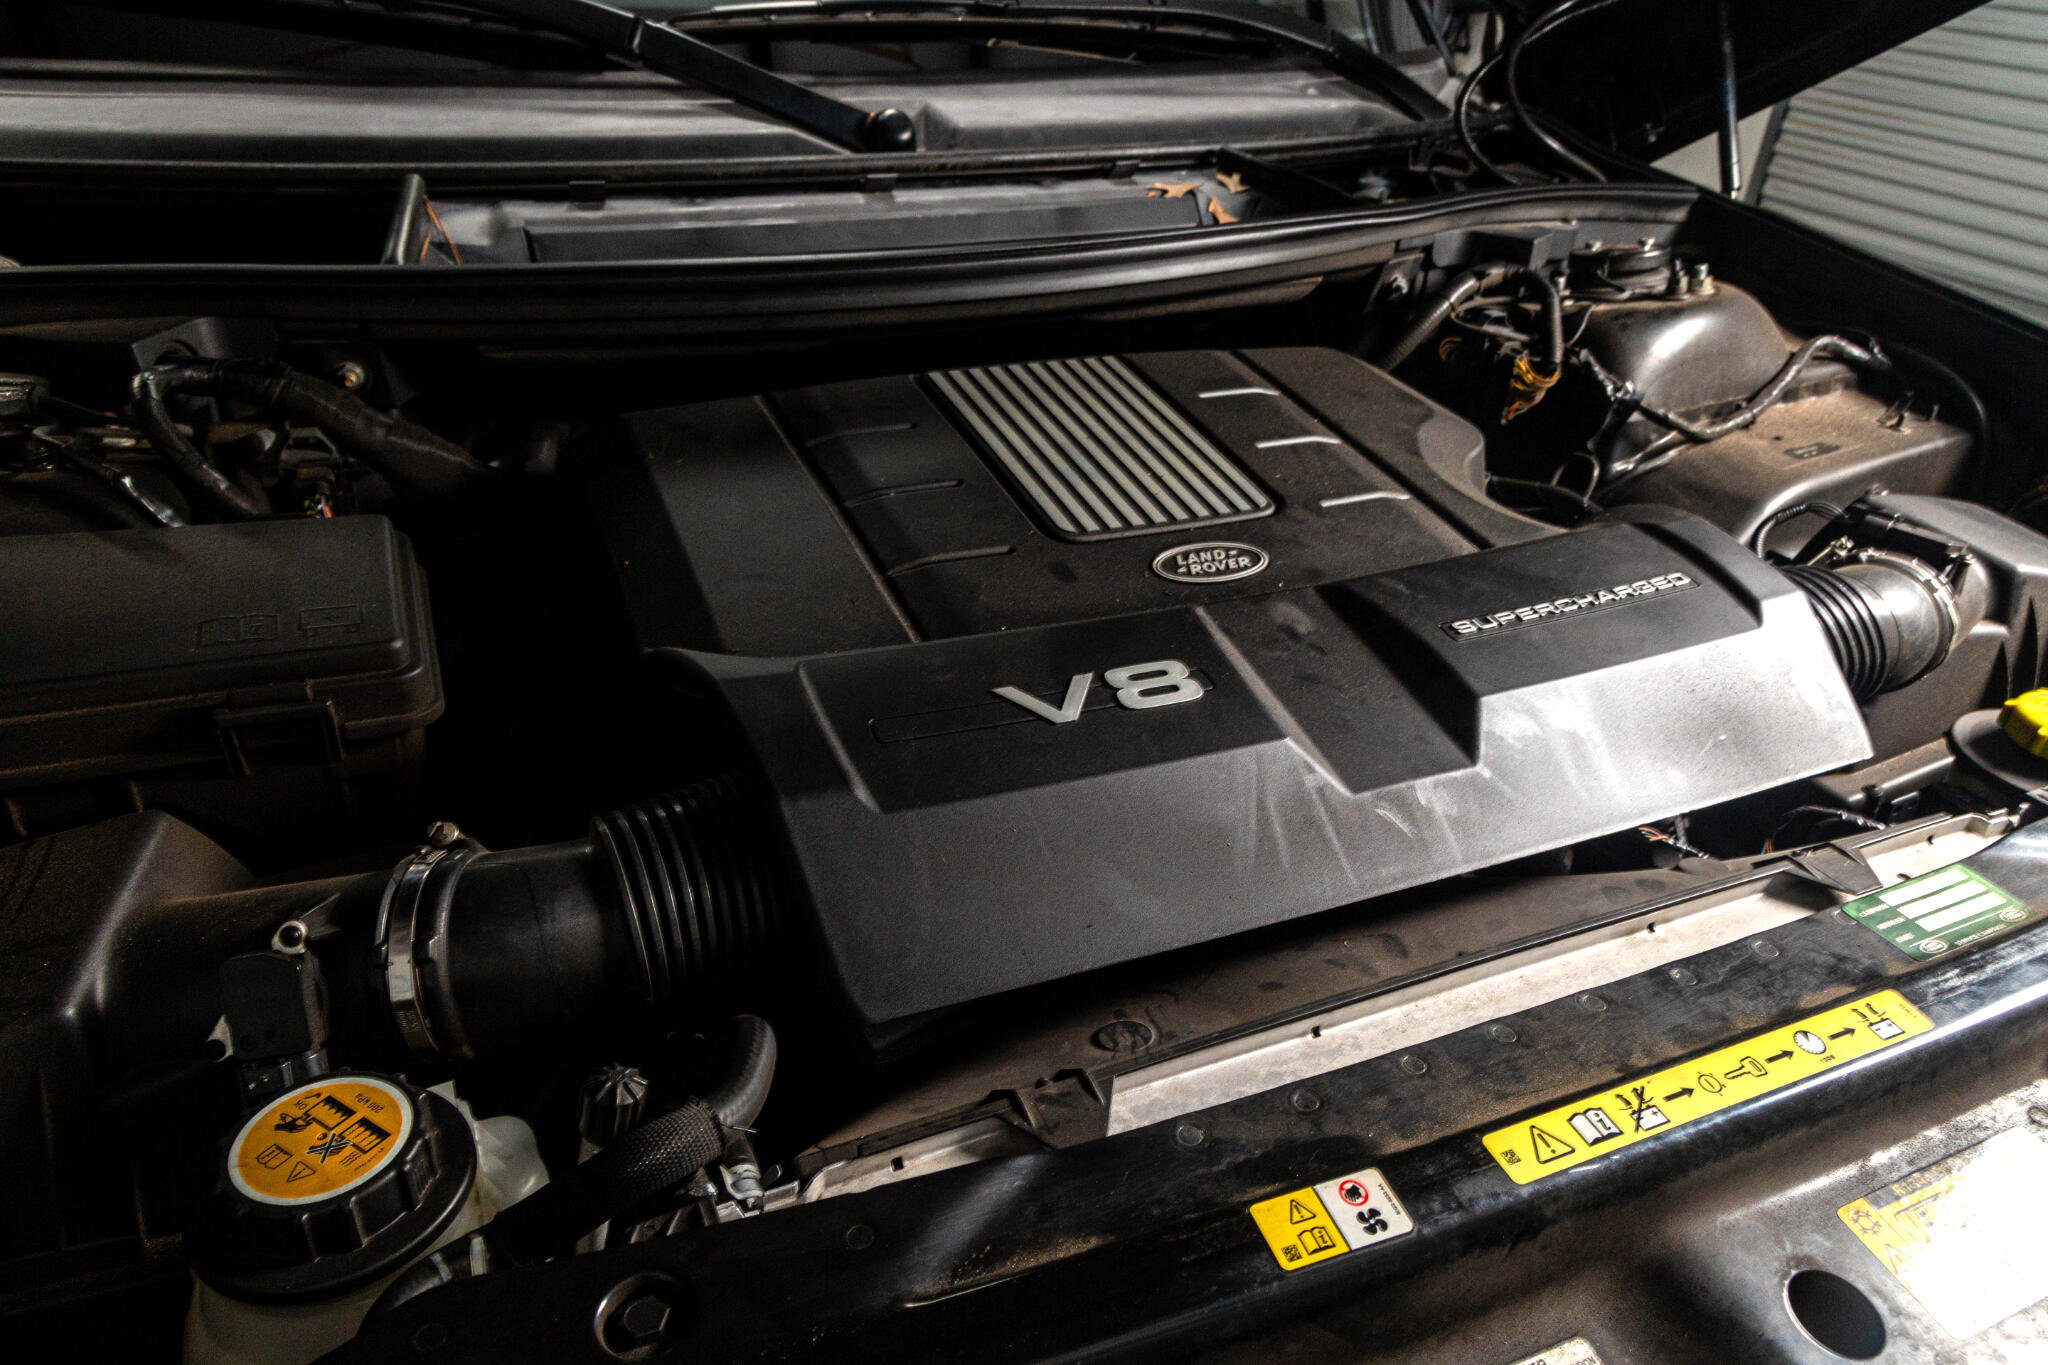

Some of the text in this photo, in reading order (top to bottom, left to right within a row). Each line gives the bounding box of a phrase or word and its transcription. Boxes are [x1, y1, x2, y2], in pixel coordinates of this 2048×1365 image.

[1175, 549, 1226, 566] LAND
[1189, 556, 1252, 575] ROVER
[1451, 571, 1692, 635] SUPERCHARGED
[991, 659, 1205, 725] V8
